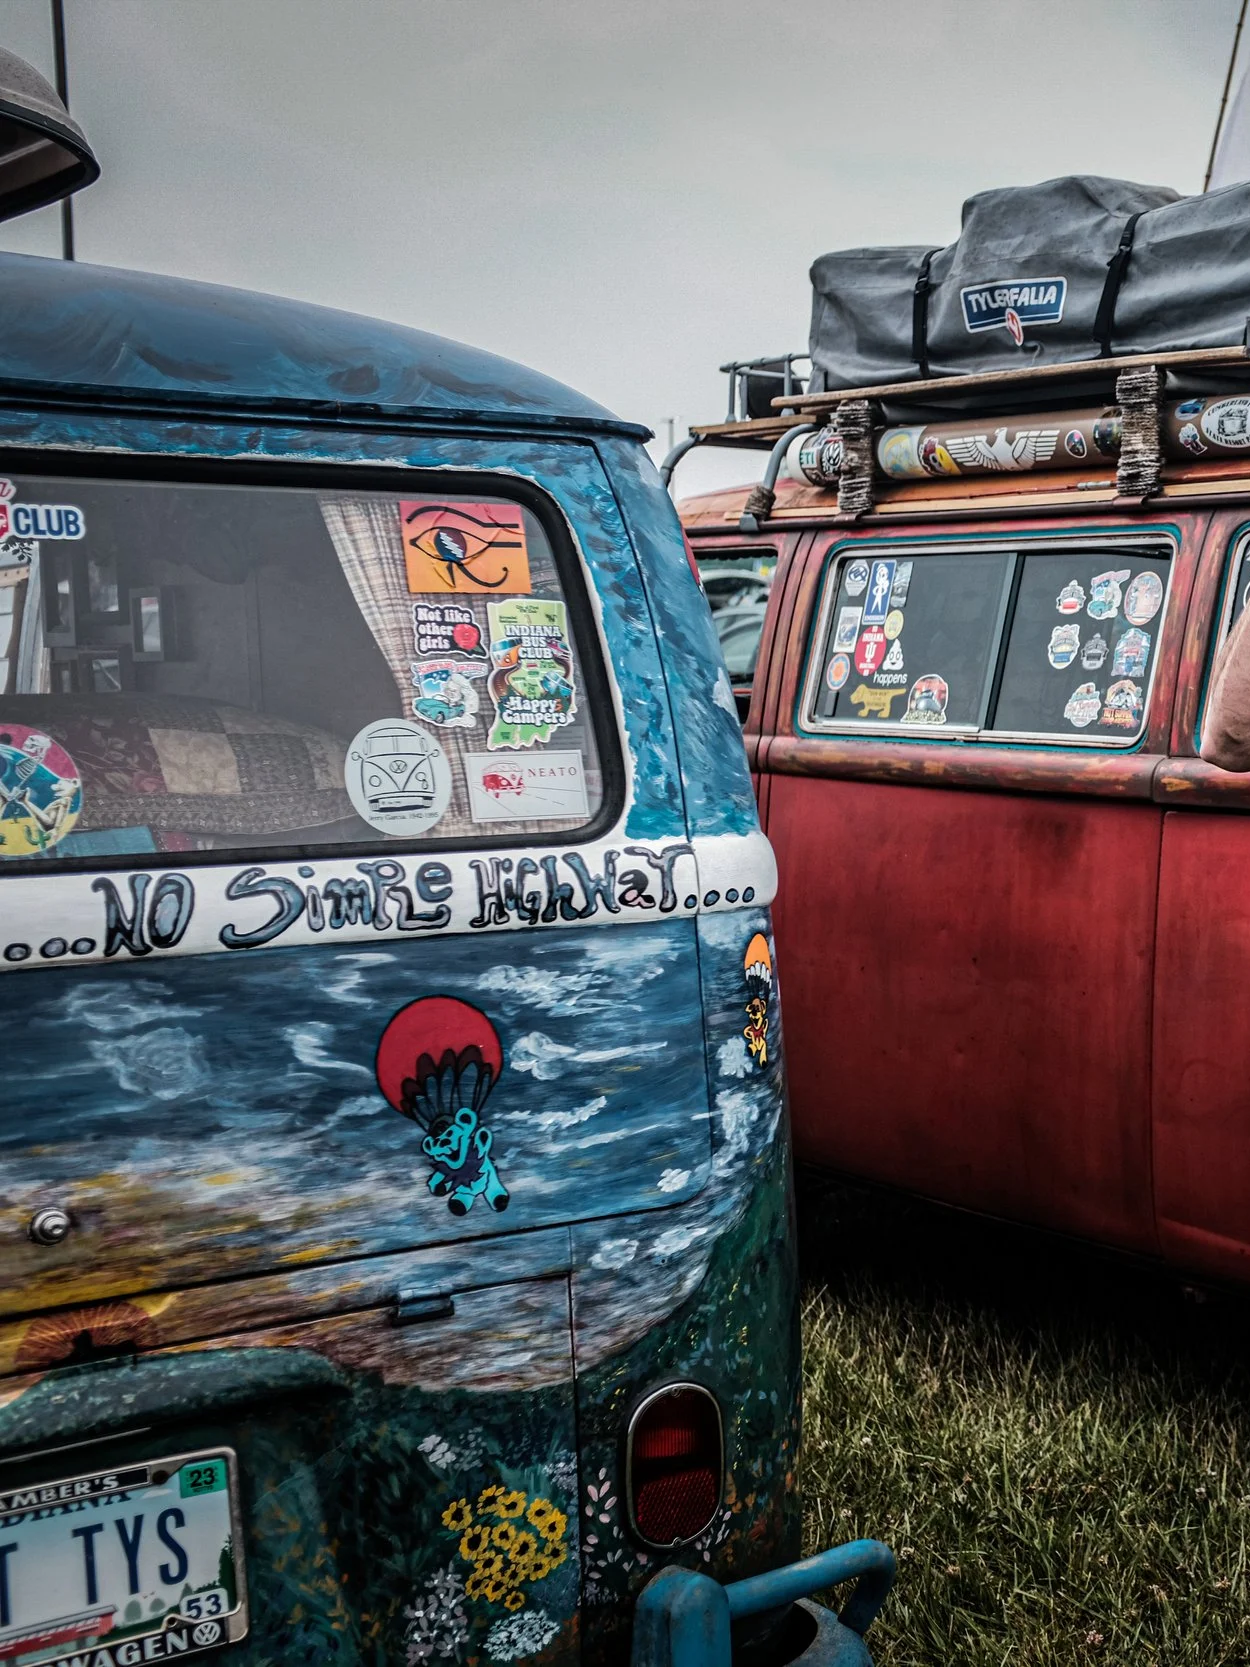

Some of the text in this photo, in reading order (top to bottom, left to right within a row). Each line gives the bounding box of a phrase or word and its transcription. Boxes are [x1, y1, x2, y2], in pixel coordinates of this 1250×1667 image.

[968, 285, 1057, 313] TYLERFALIA
[13, 507, 81, 537] CLUB
[417, 607, 471, 622] Not like
[418, 623, 453, 636] other
[505, 625, 563, 638] INDIANA
[419, 636, 450, 651] girls
[521, 637, 547, 648] BUS
[518, 647, 553, 659] CLUB
[873, 671, 908, 687] happens
[507, 697, 557, 713] Happy
[502, 711, 567, 726] Campers
[527, 766, 577, 778] NEATO
[189, 1467, 216, 1488] 23
[72, 1507, 188, 1605] TYS
[187, 1594, 221, 1619] 53
